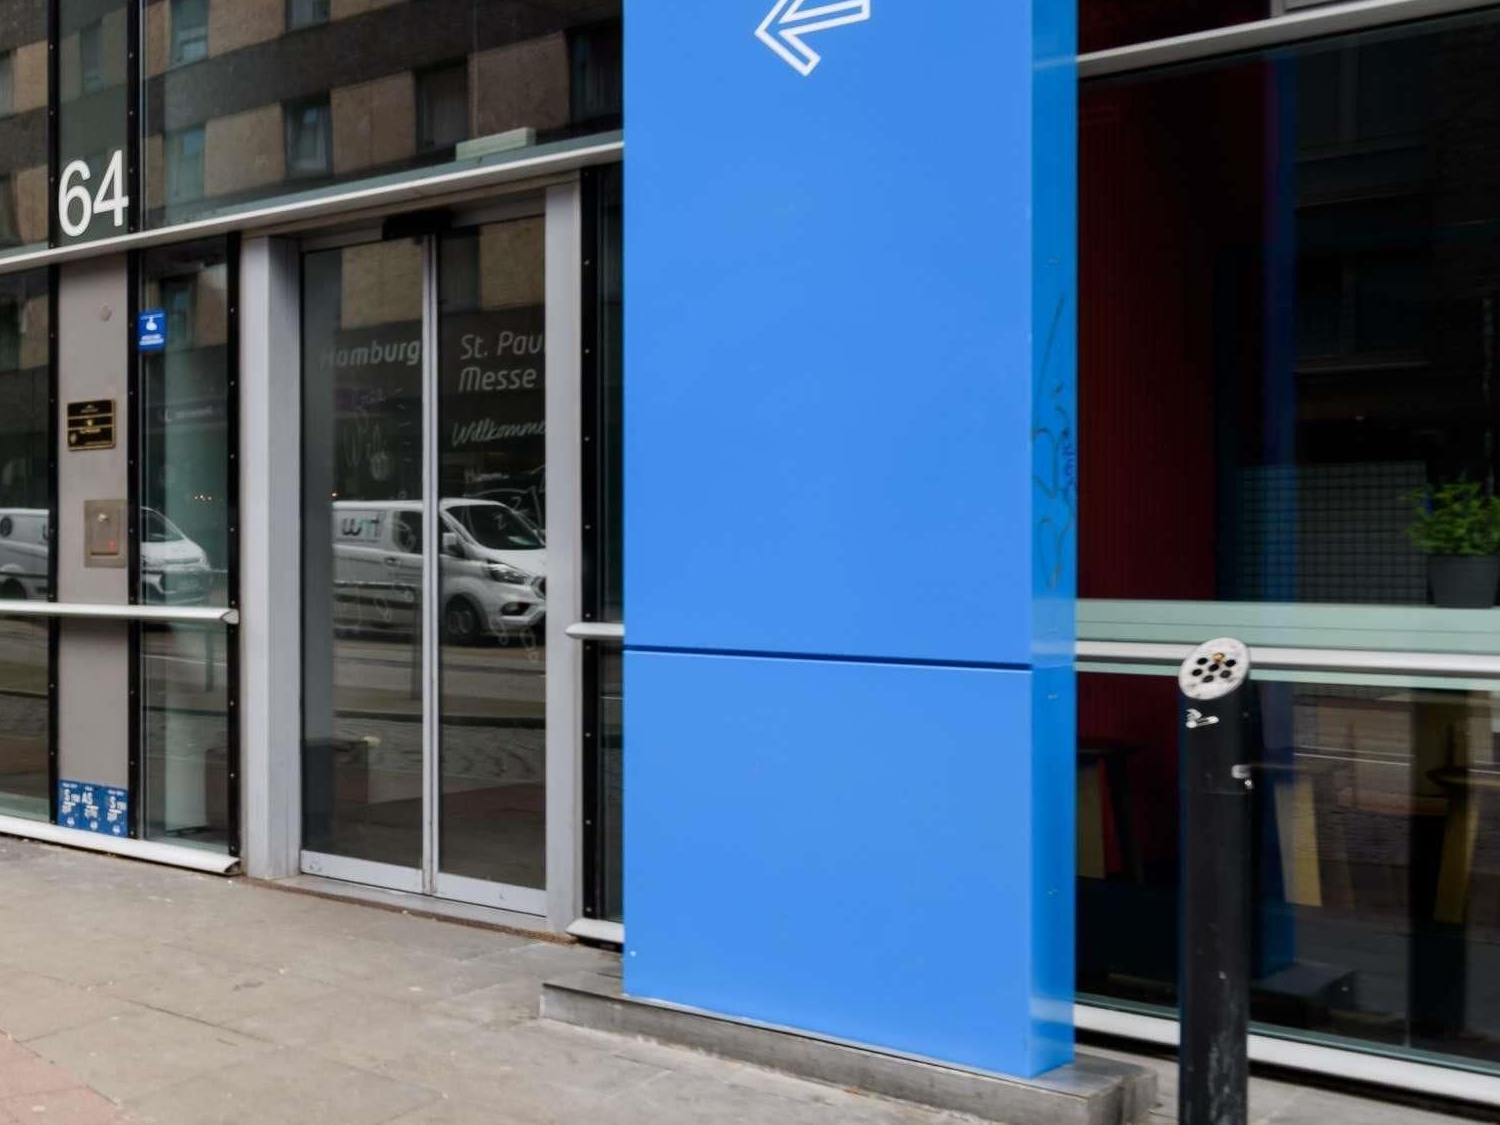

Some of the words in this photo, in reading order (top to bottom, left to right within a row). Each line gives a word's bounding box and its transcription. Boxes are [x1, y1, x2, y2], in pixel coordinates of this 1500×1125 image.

[57, 149, 129, 237] 64
[459, 333, 488, 360] St.
[497, 330, 545, 356] Pau
[457, 366, 538, 393] Messe
